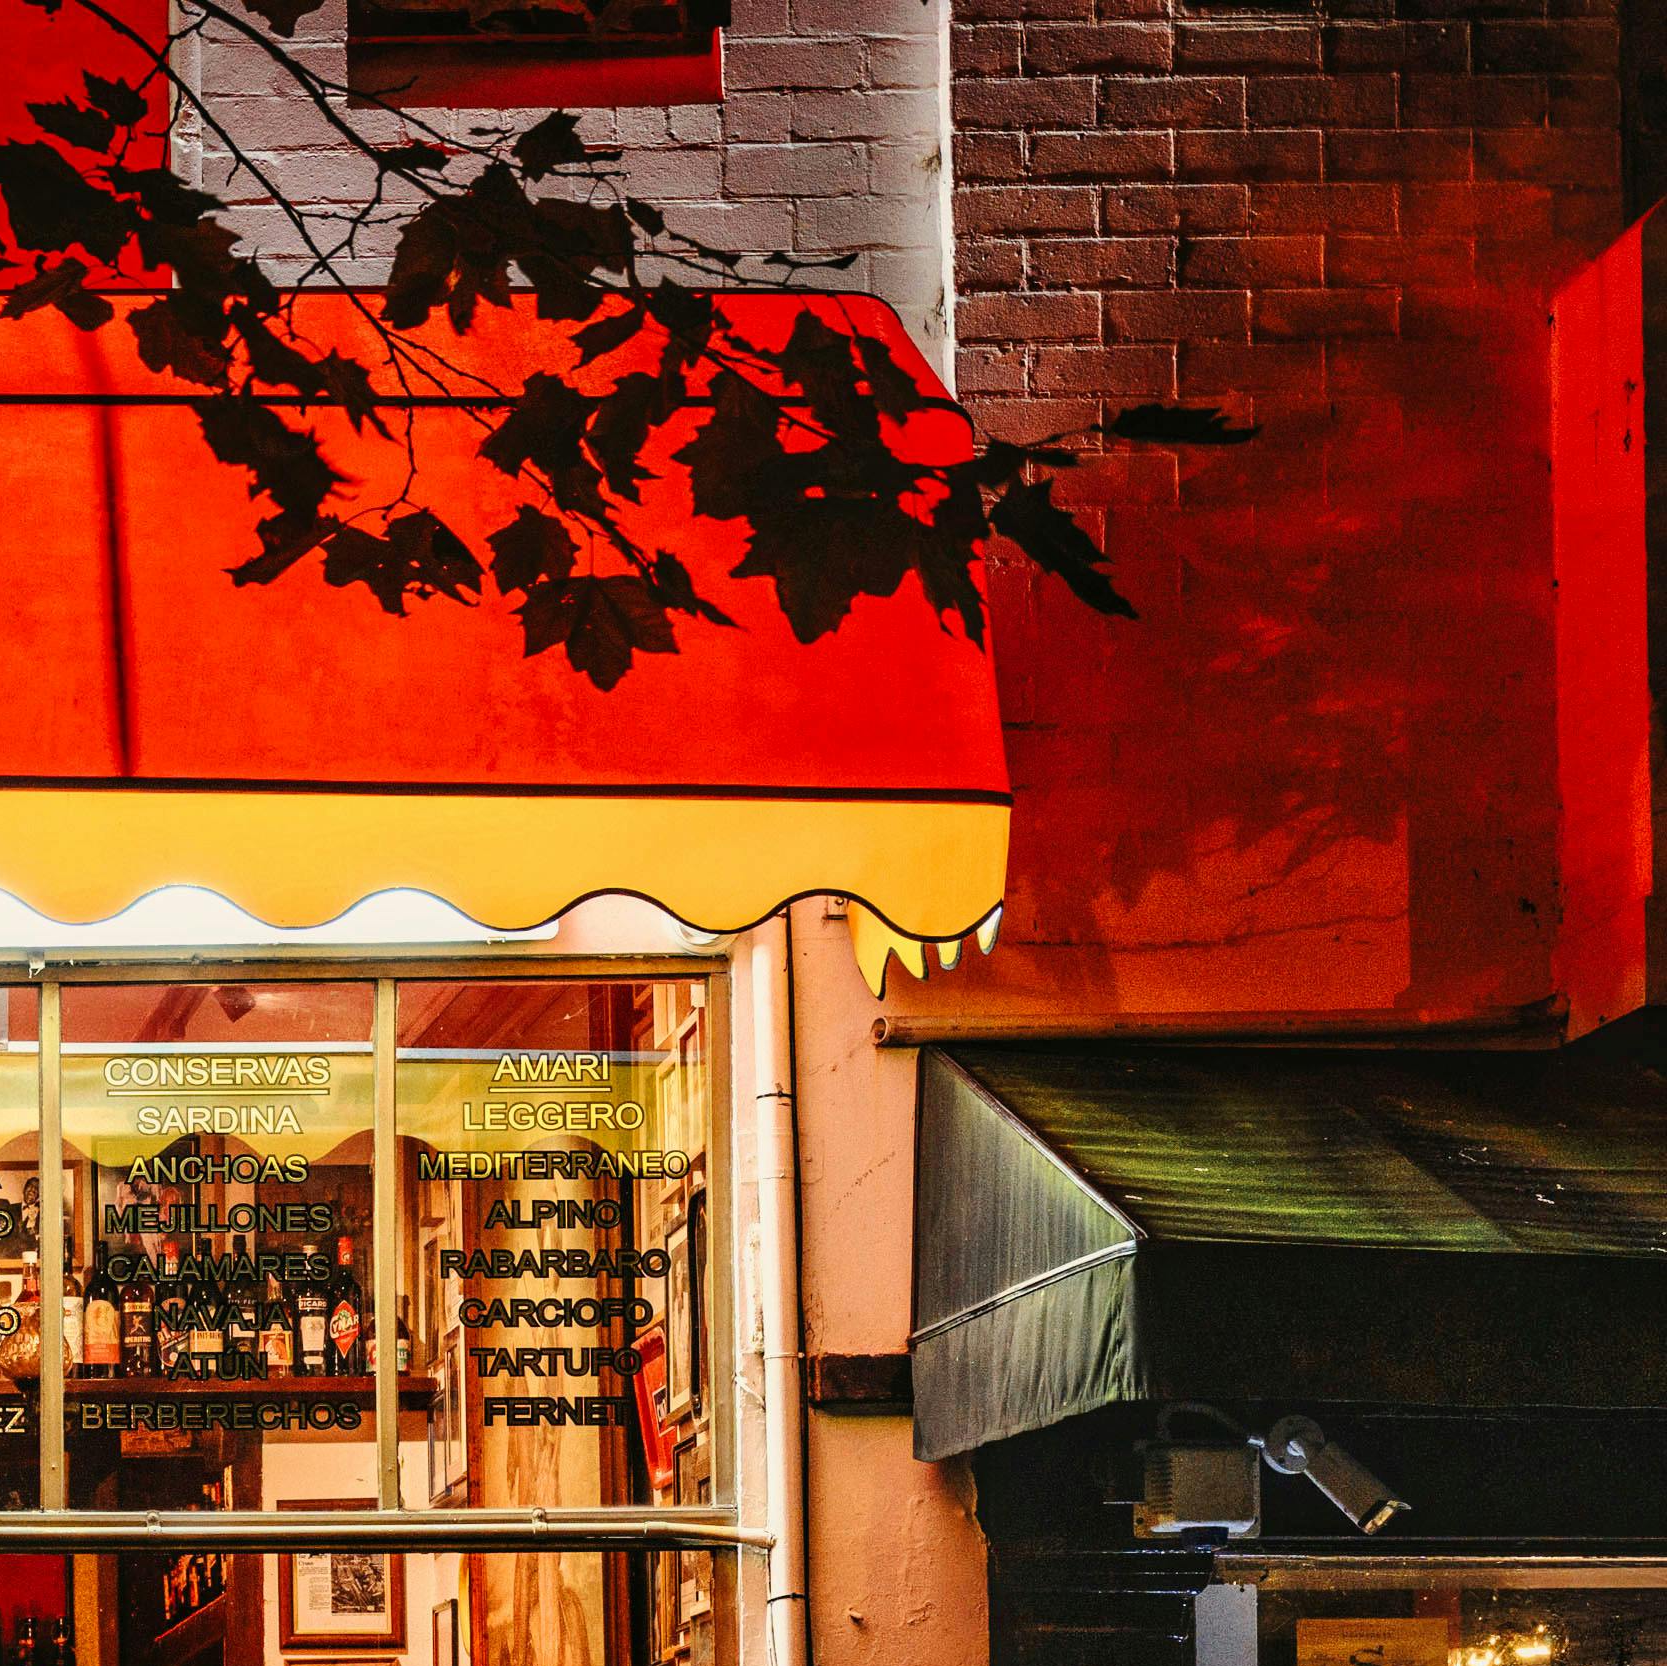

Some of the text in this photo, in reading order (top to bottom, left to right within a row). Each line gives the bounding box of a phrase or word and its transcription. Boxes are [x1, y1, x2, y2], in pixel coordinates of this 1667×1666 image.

[104, 1057, 330, 1087] CONSERVAS
[491, 1053, 610, 1082] AMARI
[136, 1105, 302, 1135] SARDINA
[462, 1102, 644, 1131] LEGGERO
[127, 1155, 309, 1185] ANCHOAS
[418, 1151, 689, 1180] MEDITERRANEO
[105, 1204, 333, 1233] MEJILLONES
[485, 1200, 624, 1230] ALPINO
[107, 1253, 331, 1283] CALAMARES
[440, 1248, 671, 1279] RABARBARO
[154, 1302, 293, 1332] NAVAJA
[298, 1299, 328, 1310] RICARD
[458, 1298, 653, 1329] CARCIOFO
[171, 1347, 269, 1381] ATÚN
[469, 1347, 643, 1377] TARTUFO
[81, 1402, 361, 1431] BERBERECHOS
[484, 1396, 629, 1427] FERNET
